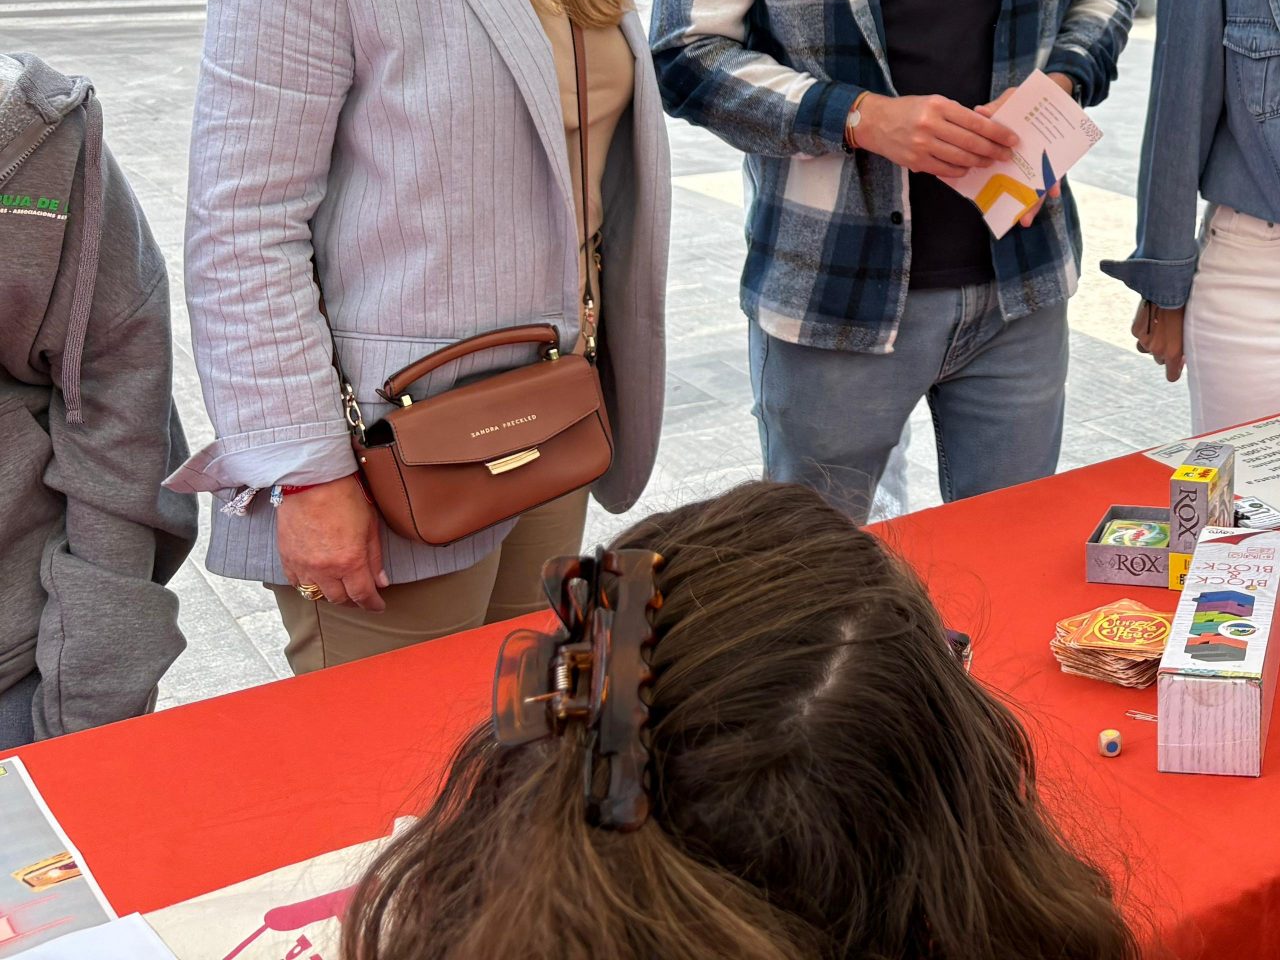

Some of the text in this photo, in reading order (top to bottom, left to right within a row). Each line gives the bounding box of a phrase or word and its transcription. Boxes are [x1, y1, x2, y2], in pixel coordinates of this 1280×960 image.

[37, 196, 60, 212] DE
[470, 414, 537, 438] SANDRA FRECKLED
[1192, 443, 1223, 463] ROX
[1173, 487, 1201, 542] ROX
[1115, 553, 1165, 577] ROX
[1202, 561, 1274, 573] BLOCK
[1194, 575, 1268, 588] BLOCK
[1226, 571, 1241, 579] &
